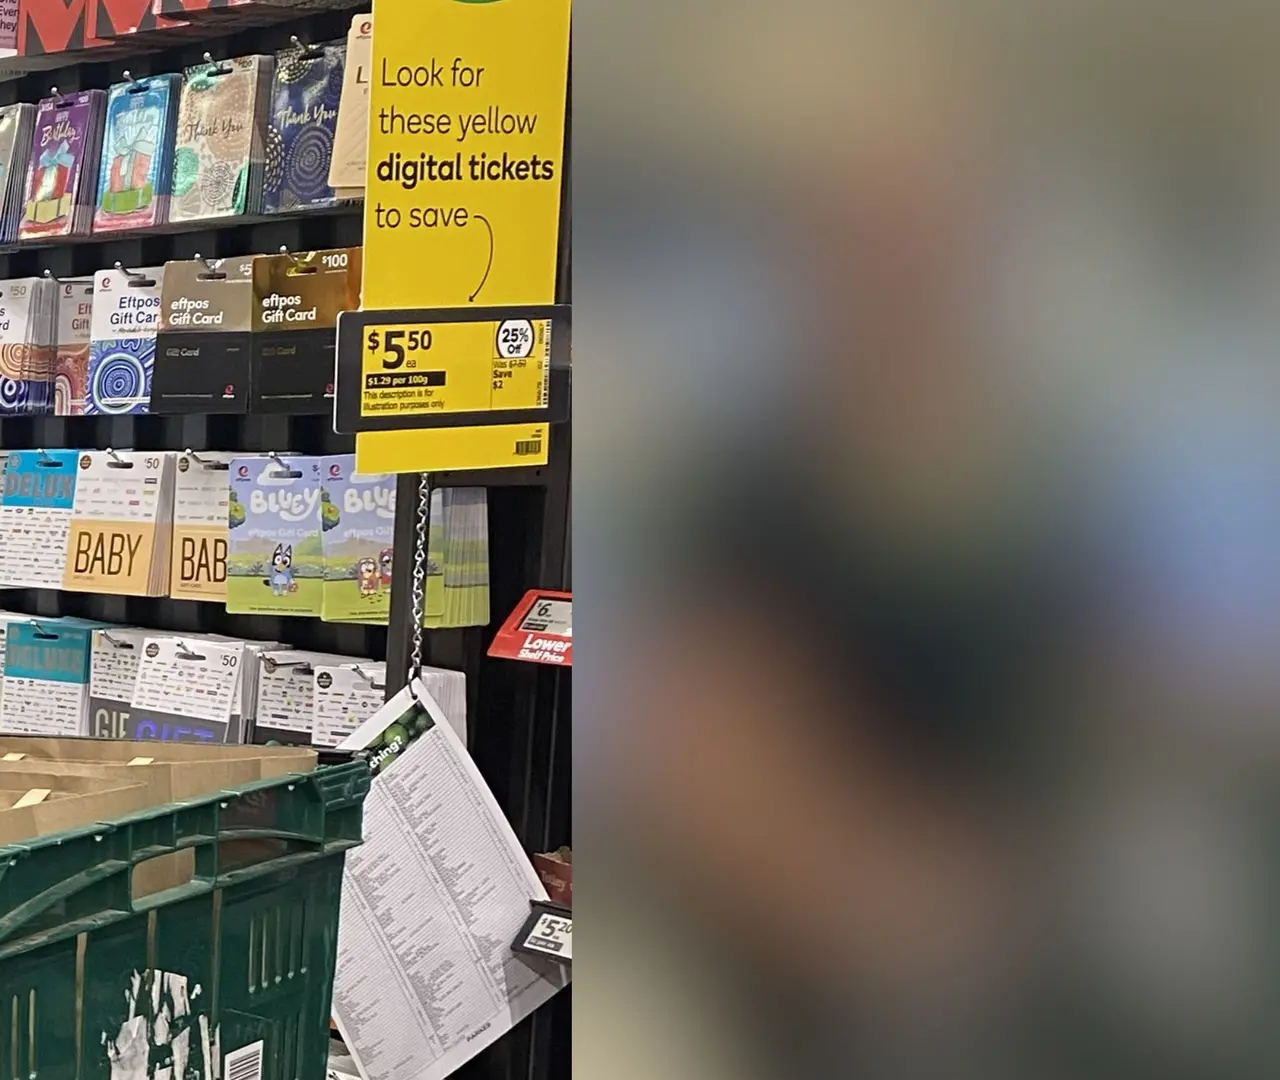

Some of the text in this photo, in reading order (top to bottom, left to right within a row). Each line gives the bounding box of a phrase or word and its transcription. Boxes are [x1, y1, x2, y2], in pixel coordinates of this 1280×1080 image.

[381, 57, 485, 87] Look for
[274, 104, 337, 128] Thank You
[185, 119, 243, 140] Thank You
[379, 106, 538, 142] these yellow
[376, 152, 554, 190] digital tickets
[375, 203, 469, 228] to save
[322, 254, 348, 268] $100
[10, 285, 27, 296] $50
[119, 295, 160, 310] Eftpos
[170, 297, 209, 311] eftpos
[262, 293, 301, 309] eftpos
[110, 312, 134, 325] Gift
[169, 311, 223, 326] Gift Card
[262, 307, 316, 324] Gift Card
[502, 328, 529, 343] 25%
[181, 347, 200, 356] Card
[507, 344, 522, 355] Off
[406, 360, 417, 368] ea
[367, 375, 428, 386] $1.29 per 100g
[493, 369, 512, 378] Save
[493, 381, 503, 391] $2
[379, 390, 416, 399] description
[399, 402, 429, 410] purposes
[431, 400, 445, 409] only
[250, 487, 320, 521] BLUEY
[74, 531, 143, 577] BABY
[523, 633, 572, 653] Lower
[220, 654, 238, 668] $50
[518, 648, 565, 662] Shelf Price
